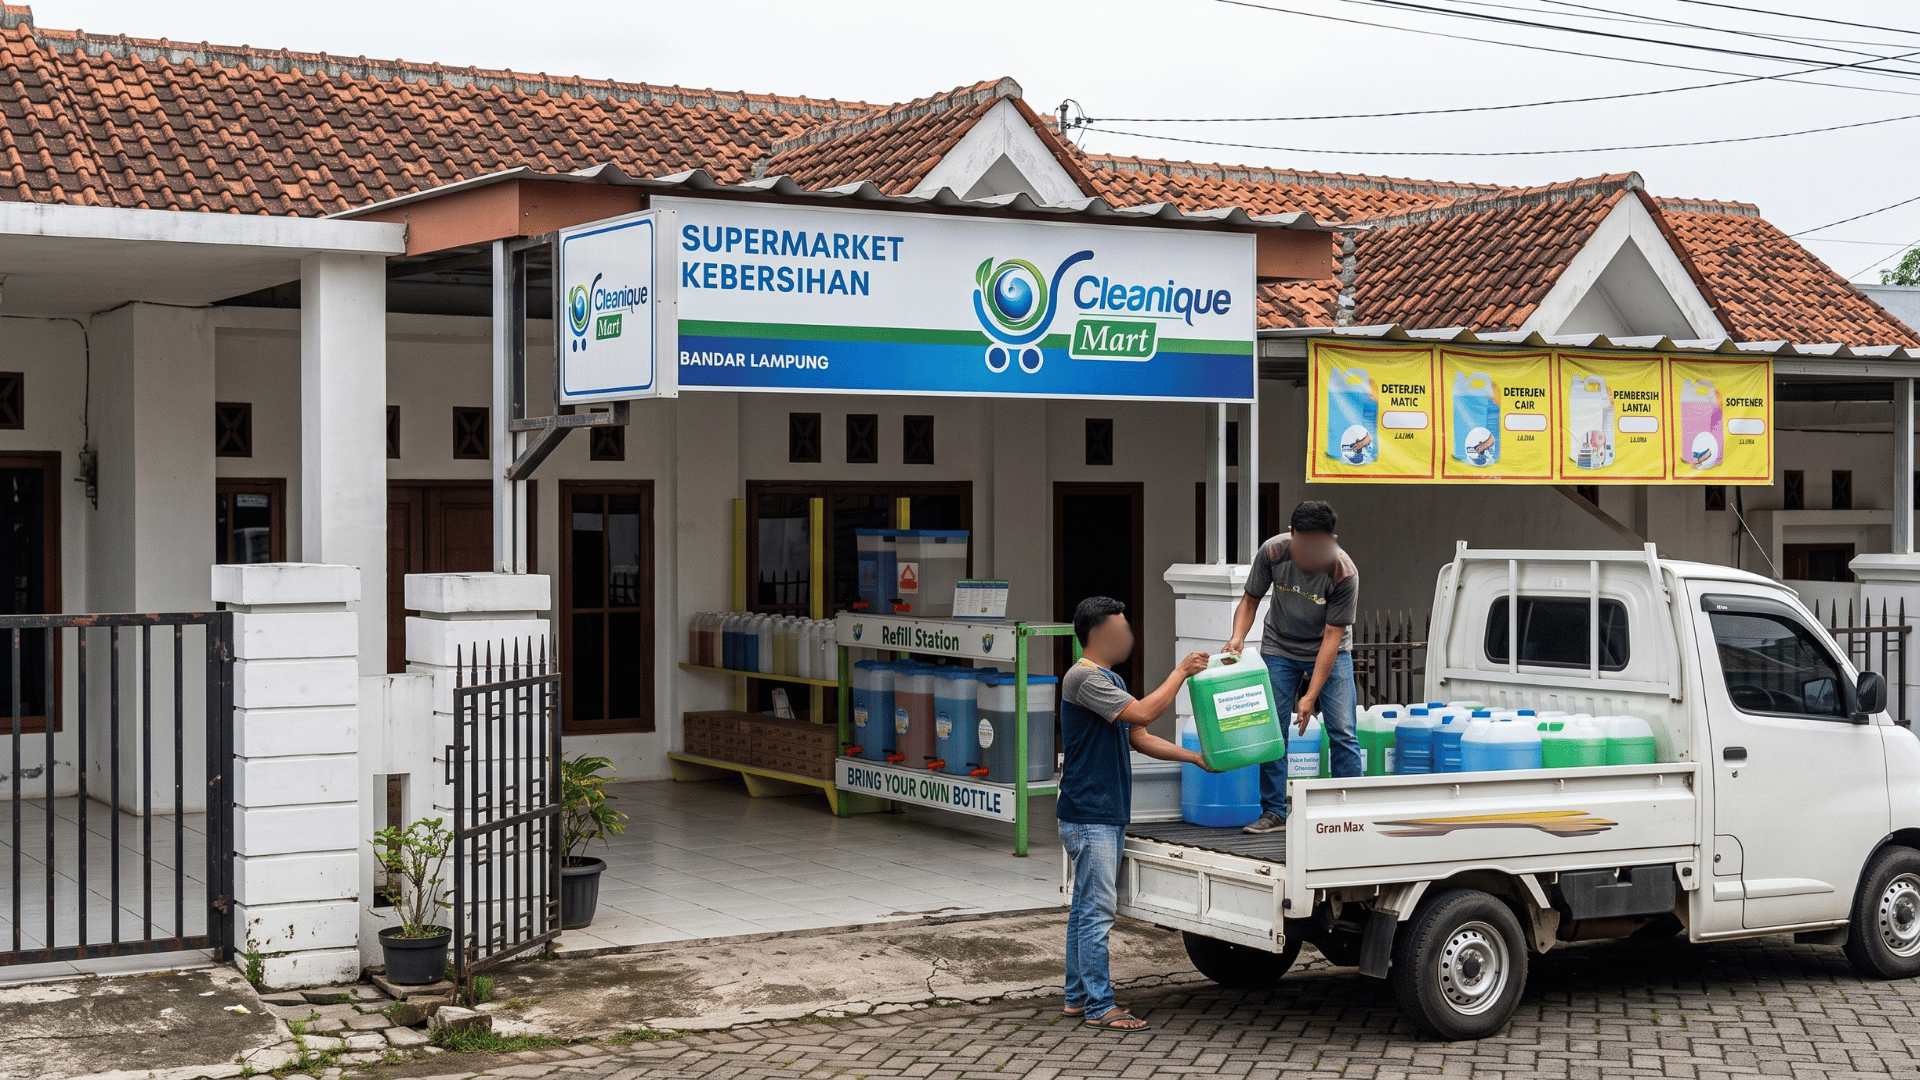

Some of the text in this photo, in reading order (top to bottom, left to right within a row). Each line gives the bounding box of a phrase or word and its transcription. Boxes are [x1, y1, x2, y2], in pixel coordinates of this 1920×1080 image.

[682, 224, 904, 262] SUPERMARKET
[682, 262, 870, 296] KEBERSIHAN
[594, 284, 648, 314] Cleanique
[1073, 274, 1232, 327] Cleanique
[598, 318, 620, 337] Mart
[1079, 325, 1149, 353] Mart
[680, 351, 829, 371] BANDAR LAMPUNG
[1381, 384, 1426, 395] DETERJEN
[1503, 387, 1545, 398] DETERJEN
[1613, 390, 1659, 401] PEMBERSIH
[1390, 397, 1419, 407] MATIC
[1514, 400, 1535, 410] CAIR
[1622, 403, 1651, 413] LANTAI
[1725, 397, 1764, 407] SOFTENER
[882, 625, 960, 651] Refill Station
[847, 766, 1001, 814] BRING YOUR OWN BOTTLE
[1316, 821, 1365, 834] Gran Max
